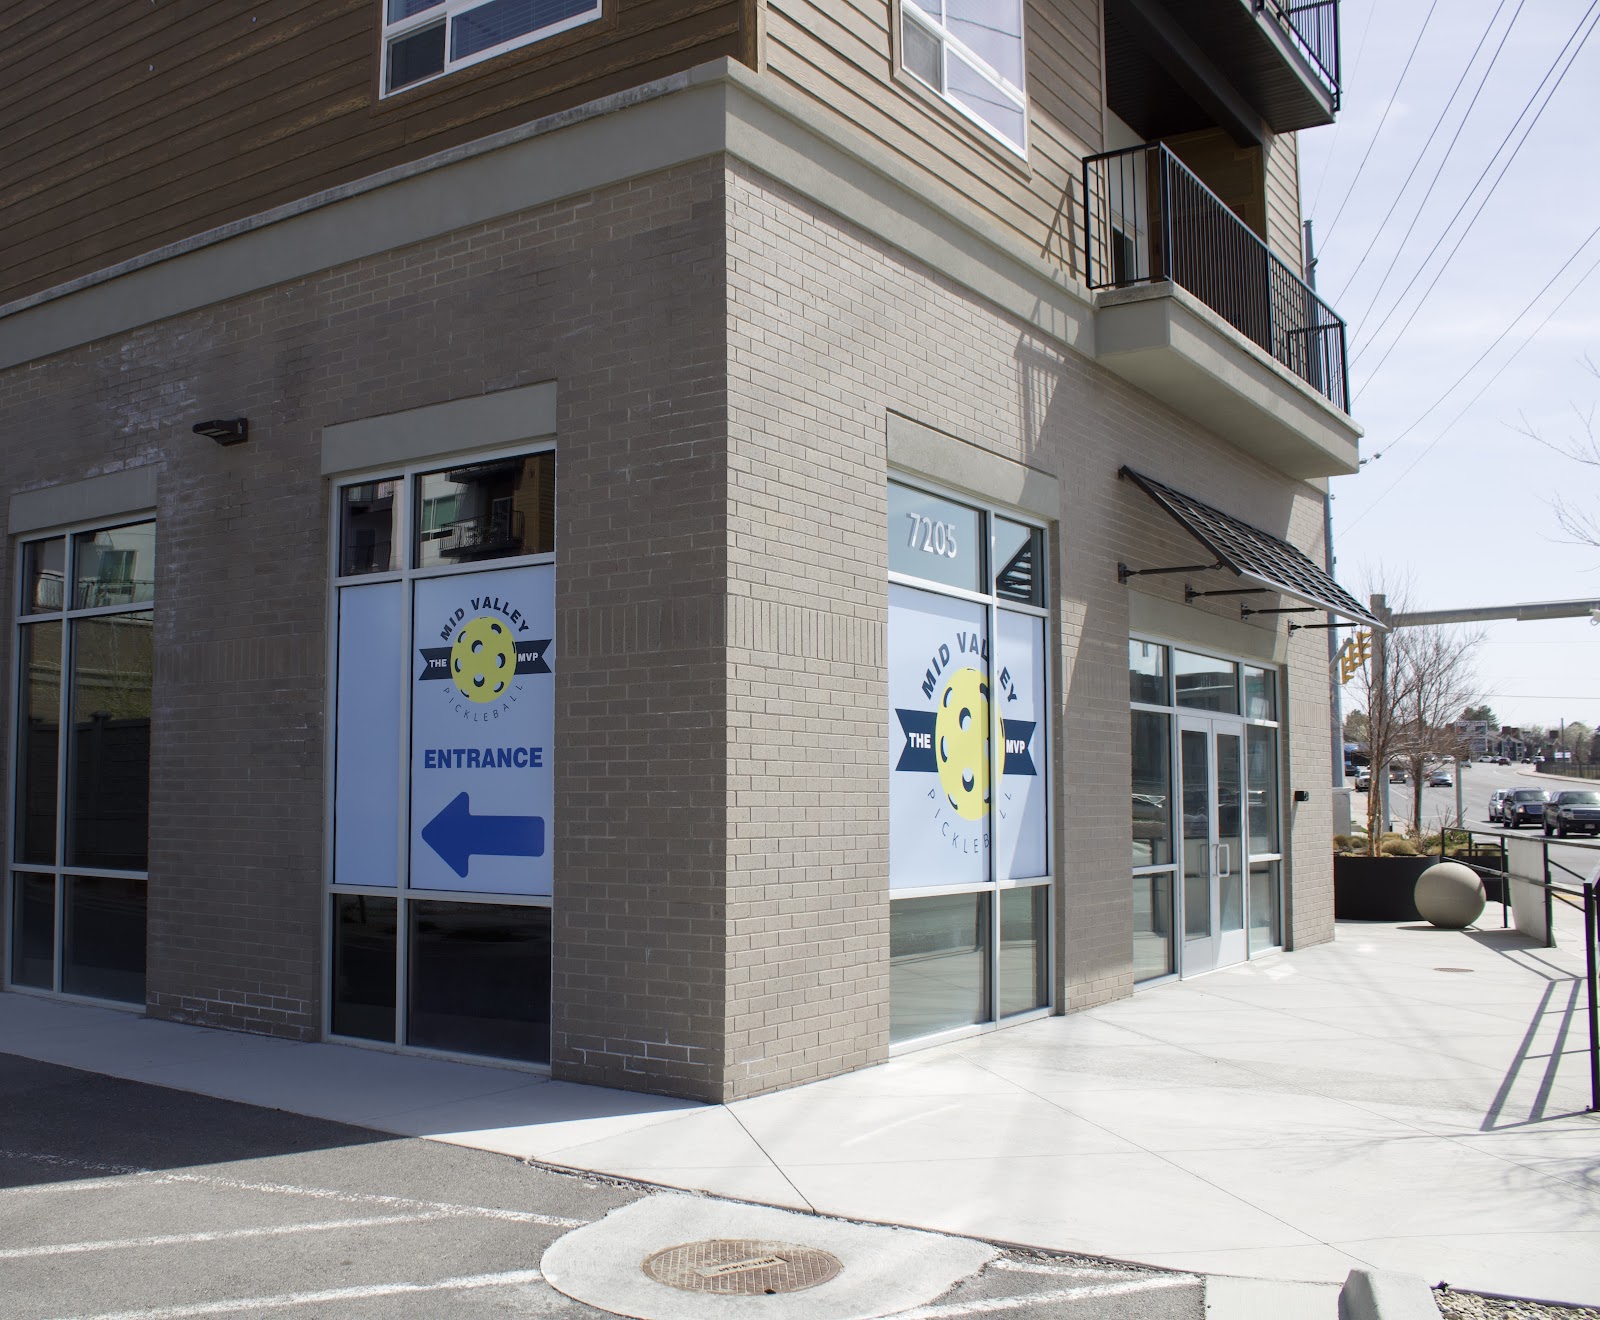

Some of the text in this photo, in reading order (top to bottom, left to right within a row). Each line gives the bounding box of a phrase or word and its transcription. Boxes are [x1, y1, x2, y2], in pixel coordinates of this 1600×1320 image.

[909, 512, 957, 558] 7205
[440, 596, 530, 641] MID VALLEY
[429, 652, 539, 668] THE MVP
[921, 631, 1017, 702] MID VALEY
[443, 684, 524, 722] PICKLEBALL
[424, 747, 543, 769] ENTRANCE
[909, 732, 1026, 754] THE MVP
[927, 788, 1012, 854] PICKLEBLL
